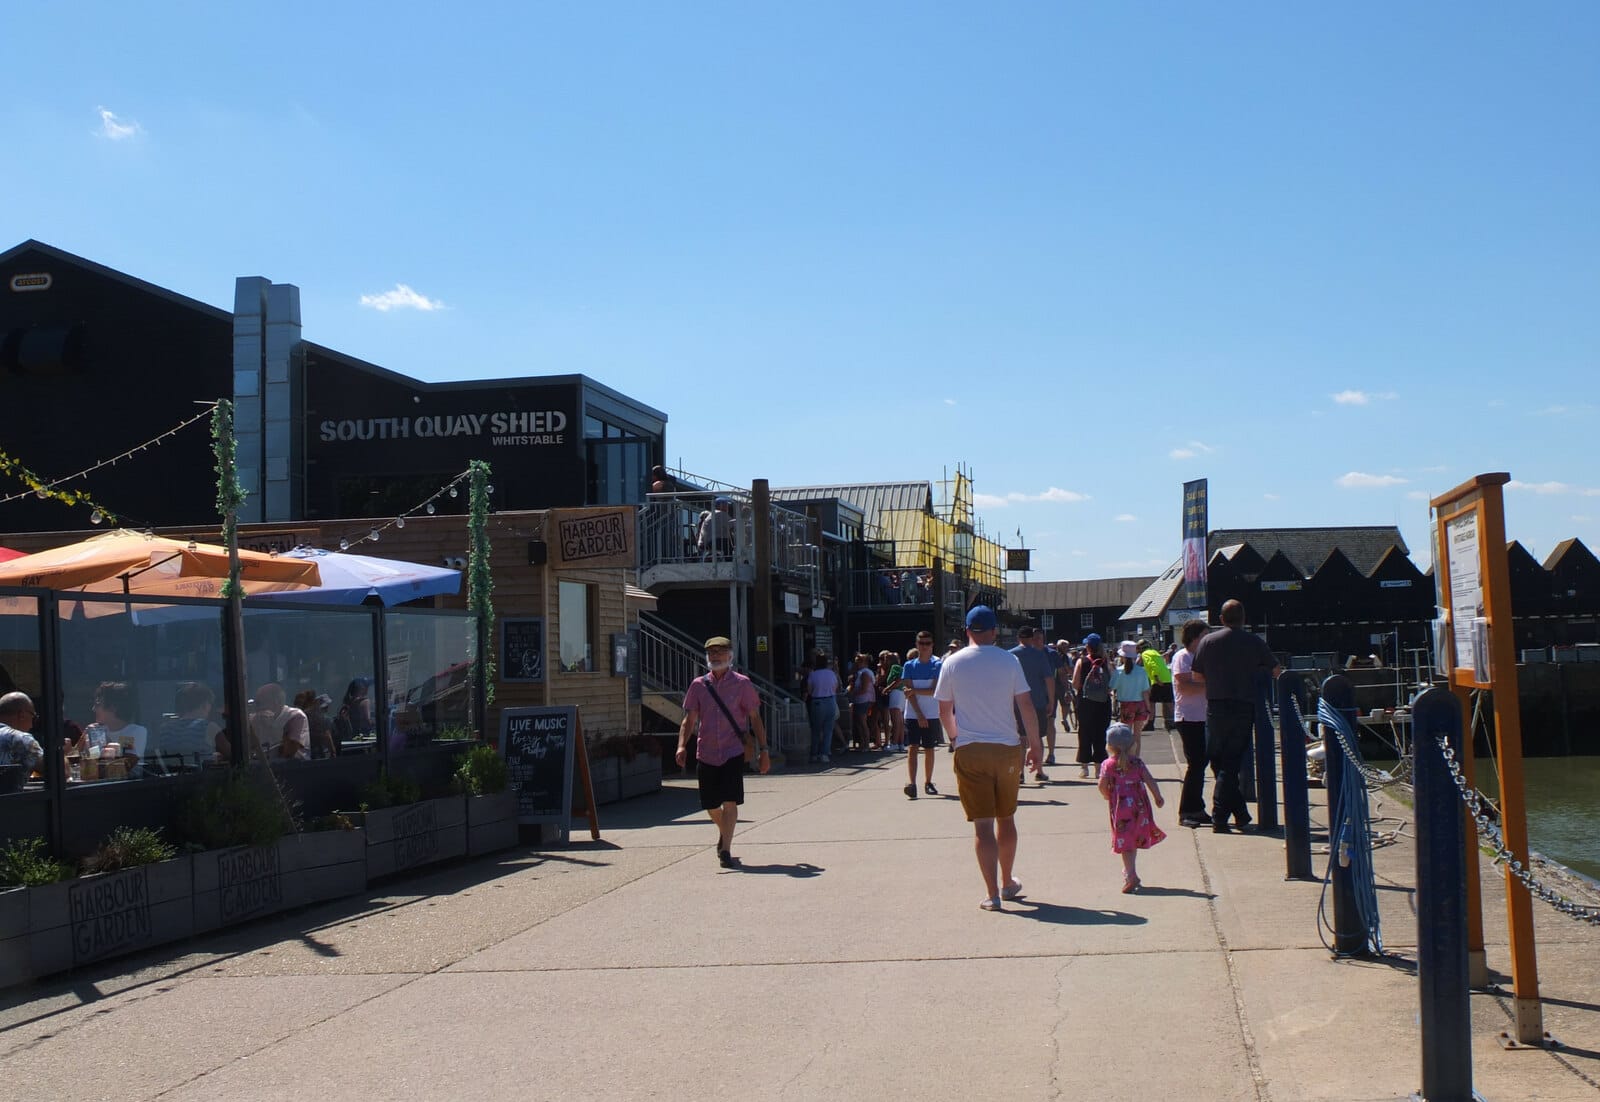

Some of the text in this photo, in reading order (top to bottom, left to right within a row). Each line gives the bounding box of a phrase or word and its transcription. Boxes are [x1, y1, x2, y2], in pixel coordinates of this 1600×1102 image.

[320, 410, 567, 441] SOUTH QUAY SHED
[492, 434, 563, 446] WHITSTABLE
[563, 517, 621, 540] HARBOUR
[565, 533, 623, 556] GARDEN
[510, 717, 567, 731] LIVE MUSIC
[222, 849, 277, 888] HARBOUR
[73, 871, 144, 921] HARBOUR
[223, 877, 279, 916] GARDEN
[76, 904, 147, 954] GARDEN
